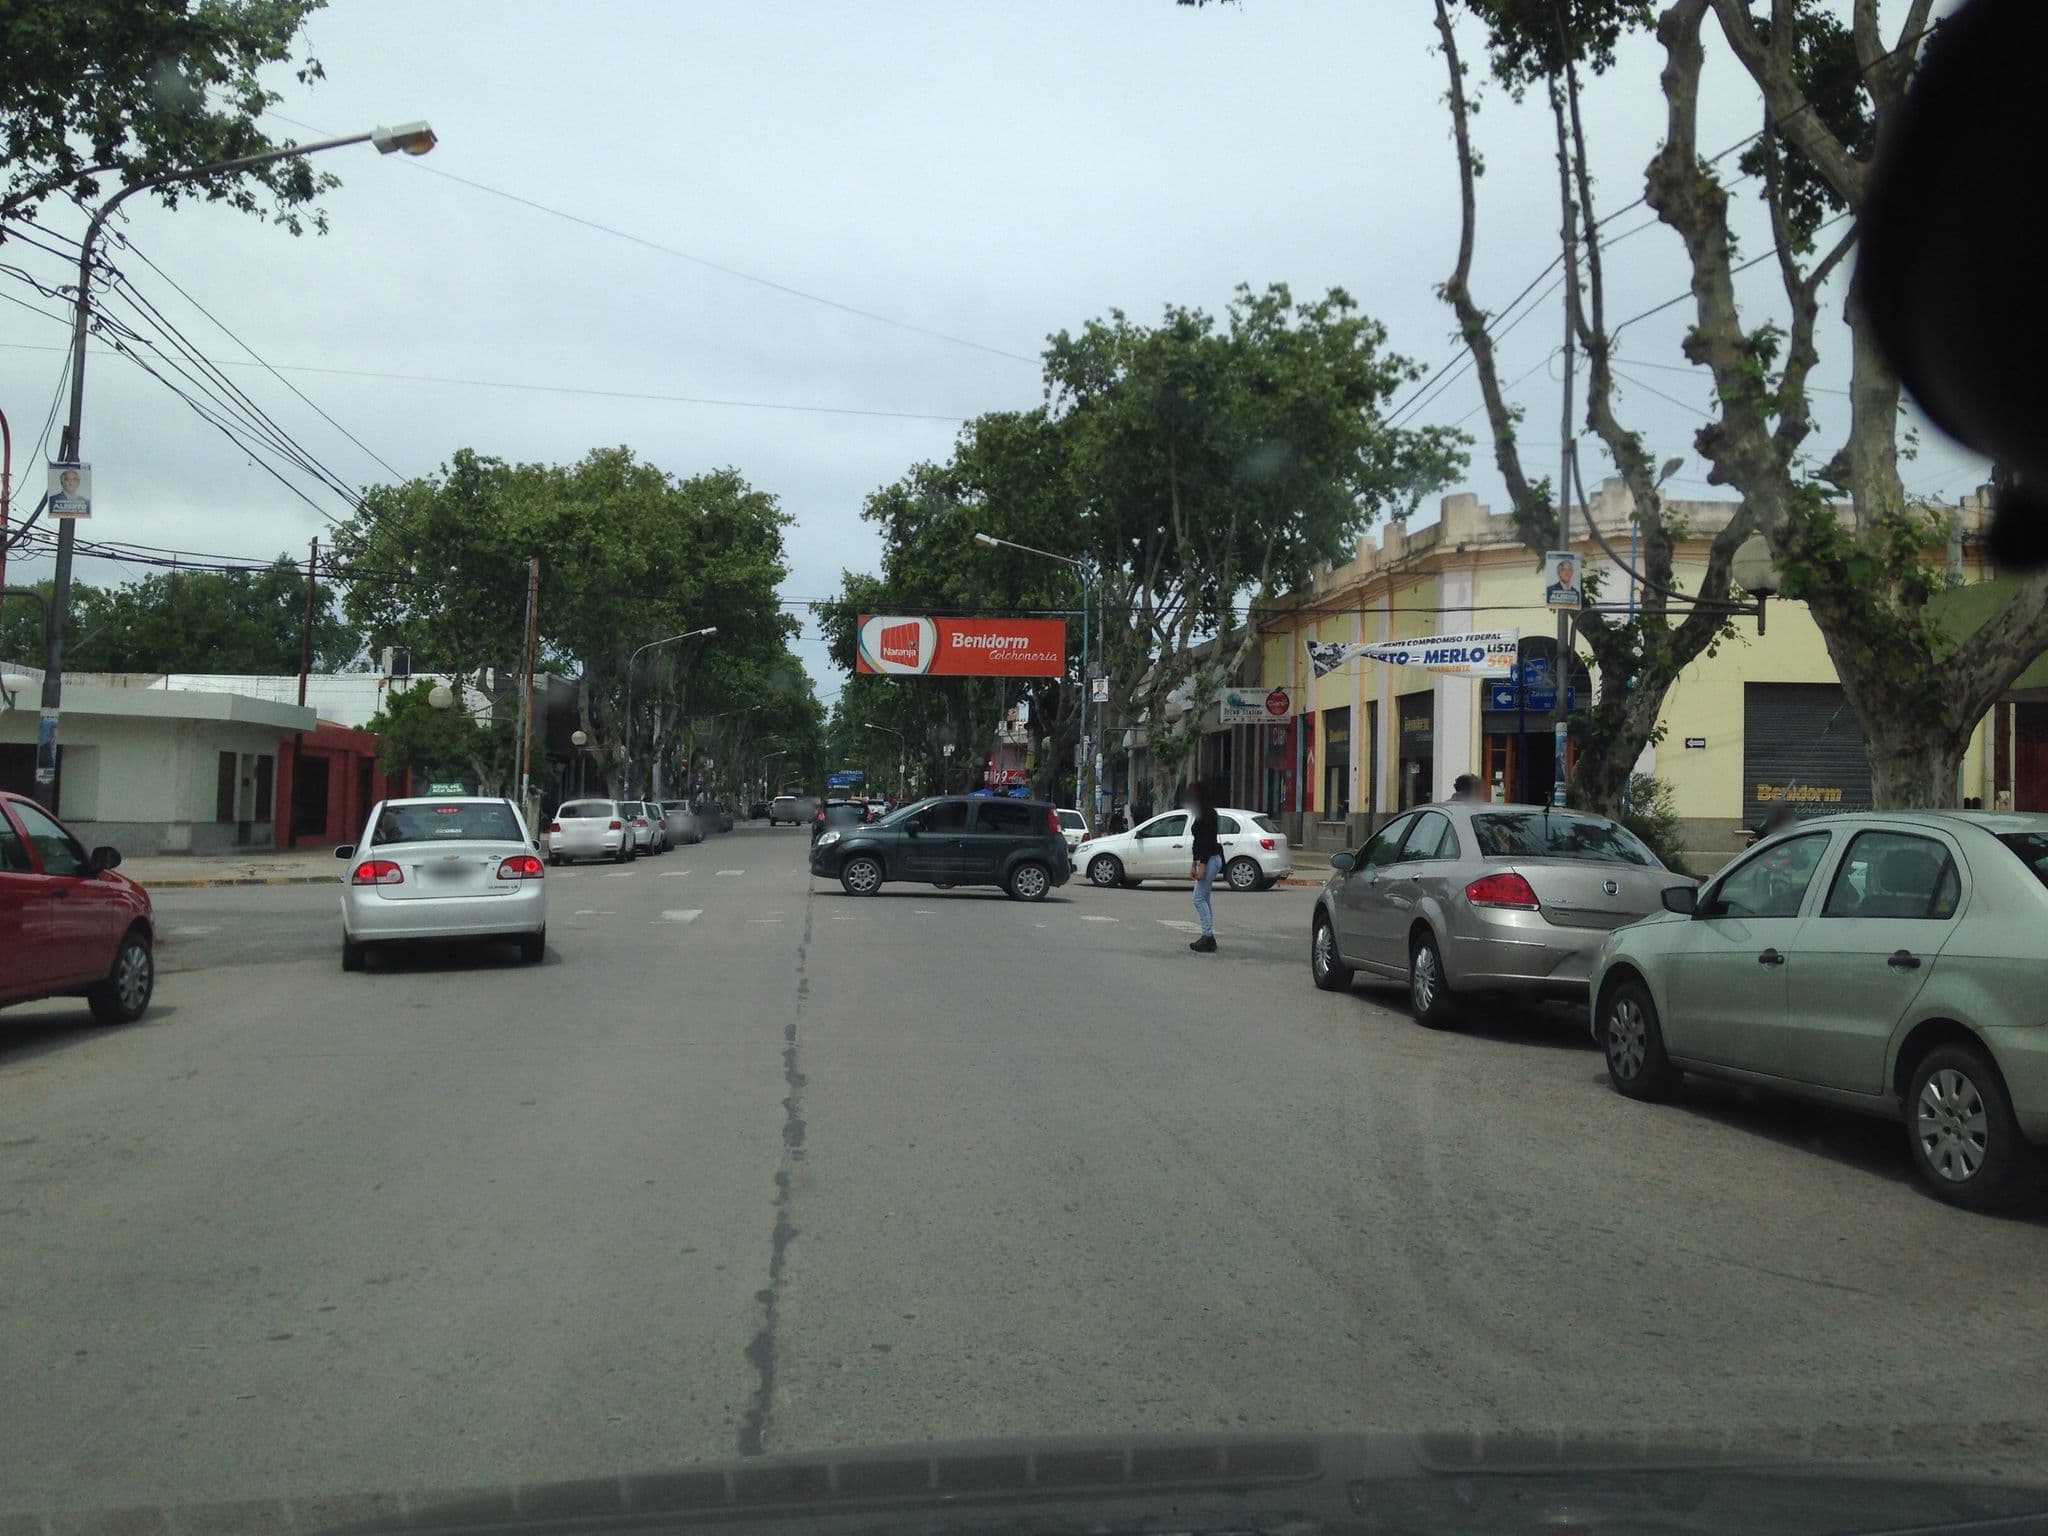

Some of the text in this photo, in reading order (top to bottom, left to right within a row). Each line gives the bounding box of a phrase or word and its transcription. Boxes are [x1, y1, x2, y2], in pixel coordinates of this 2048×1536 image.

[951, 632, 1029, 649] Benidorm
[1407, 636, 1463, 647] COMPROMISO
[1465, 633, 1501, 642] FEDERAL
[883, 646, 916, 658] Naranja
[1487, 643, 1517, 653] LISTA
[1423, 647, 1485, 664] MERLO
